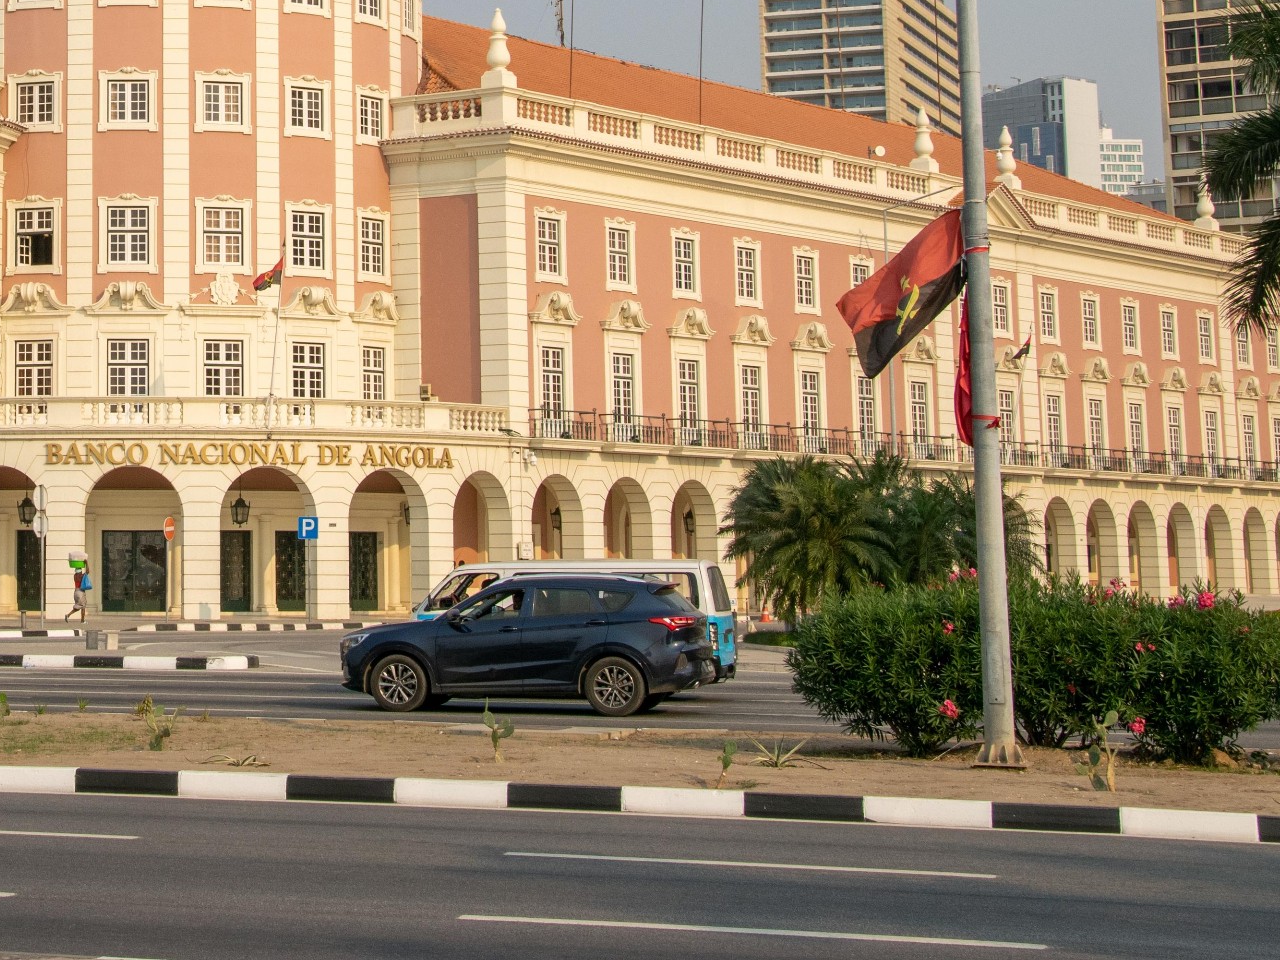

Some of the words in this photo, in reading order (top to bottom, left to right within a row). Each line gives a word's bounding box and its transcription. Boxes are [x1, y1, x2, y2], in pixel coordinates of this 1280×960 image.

[45, 442, 149, 465] BANCO
[158, 442, 307, 466] NACIONAL
[317, 444, 352, 466] DE
[360, 444, 454, 469] ANGOLA
[302, 518, 315, 537] P
